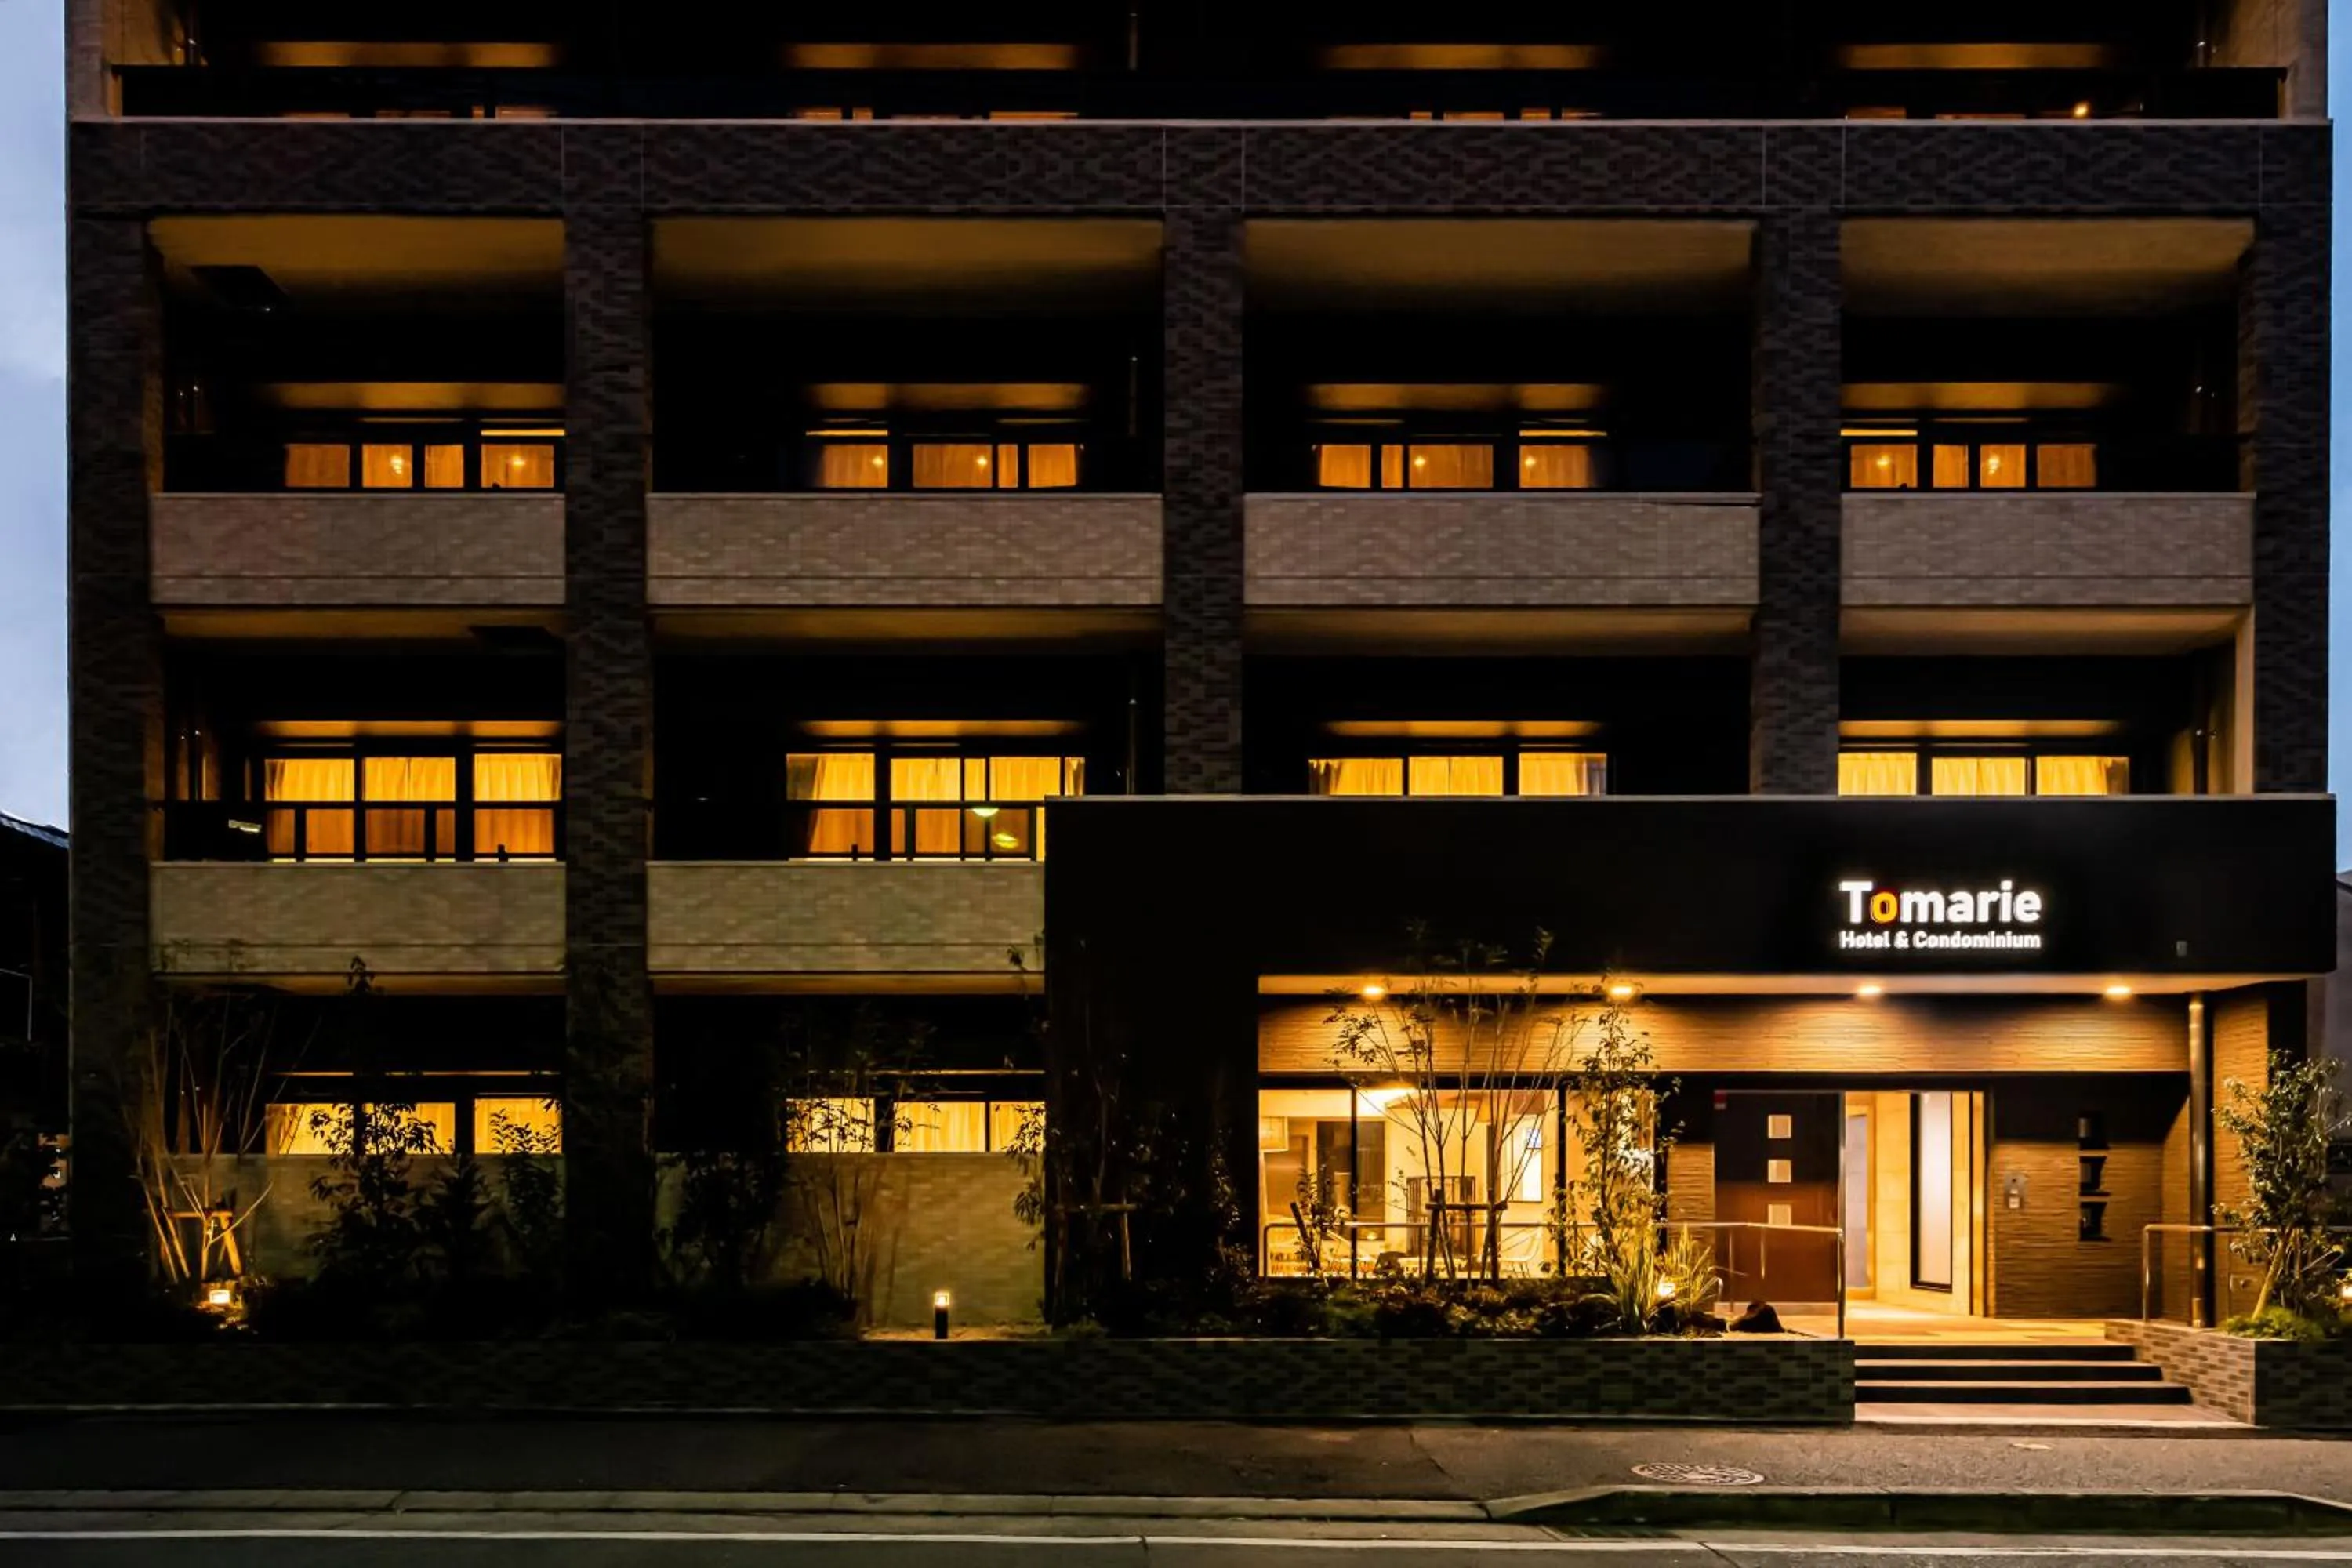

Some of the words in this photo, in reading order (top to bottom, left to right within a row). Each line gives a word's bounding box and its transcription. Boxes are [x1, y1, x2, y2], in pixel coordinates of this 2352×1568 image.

[1839, 880, 2042, 924] Tomarie
[1839, 931, 1891, 948] Hotel
[1894, 931, 1909, 949] &
[1913, 931, 2041, 948] Condominium
